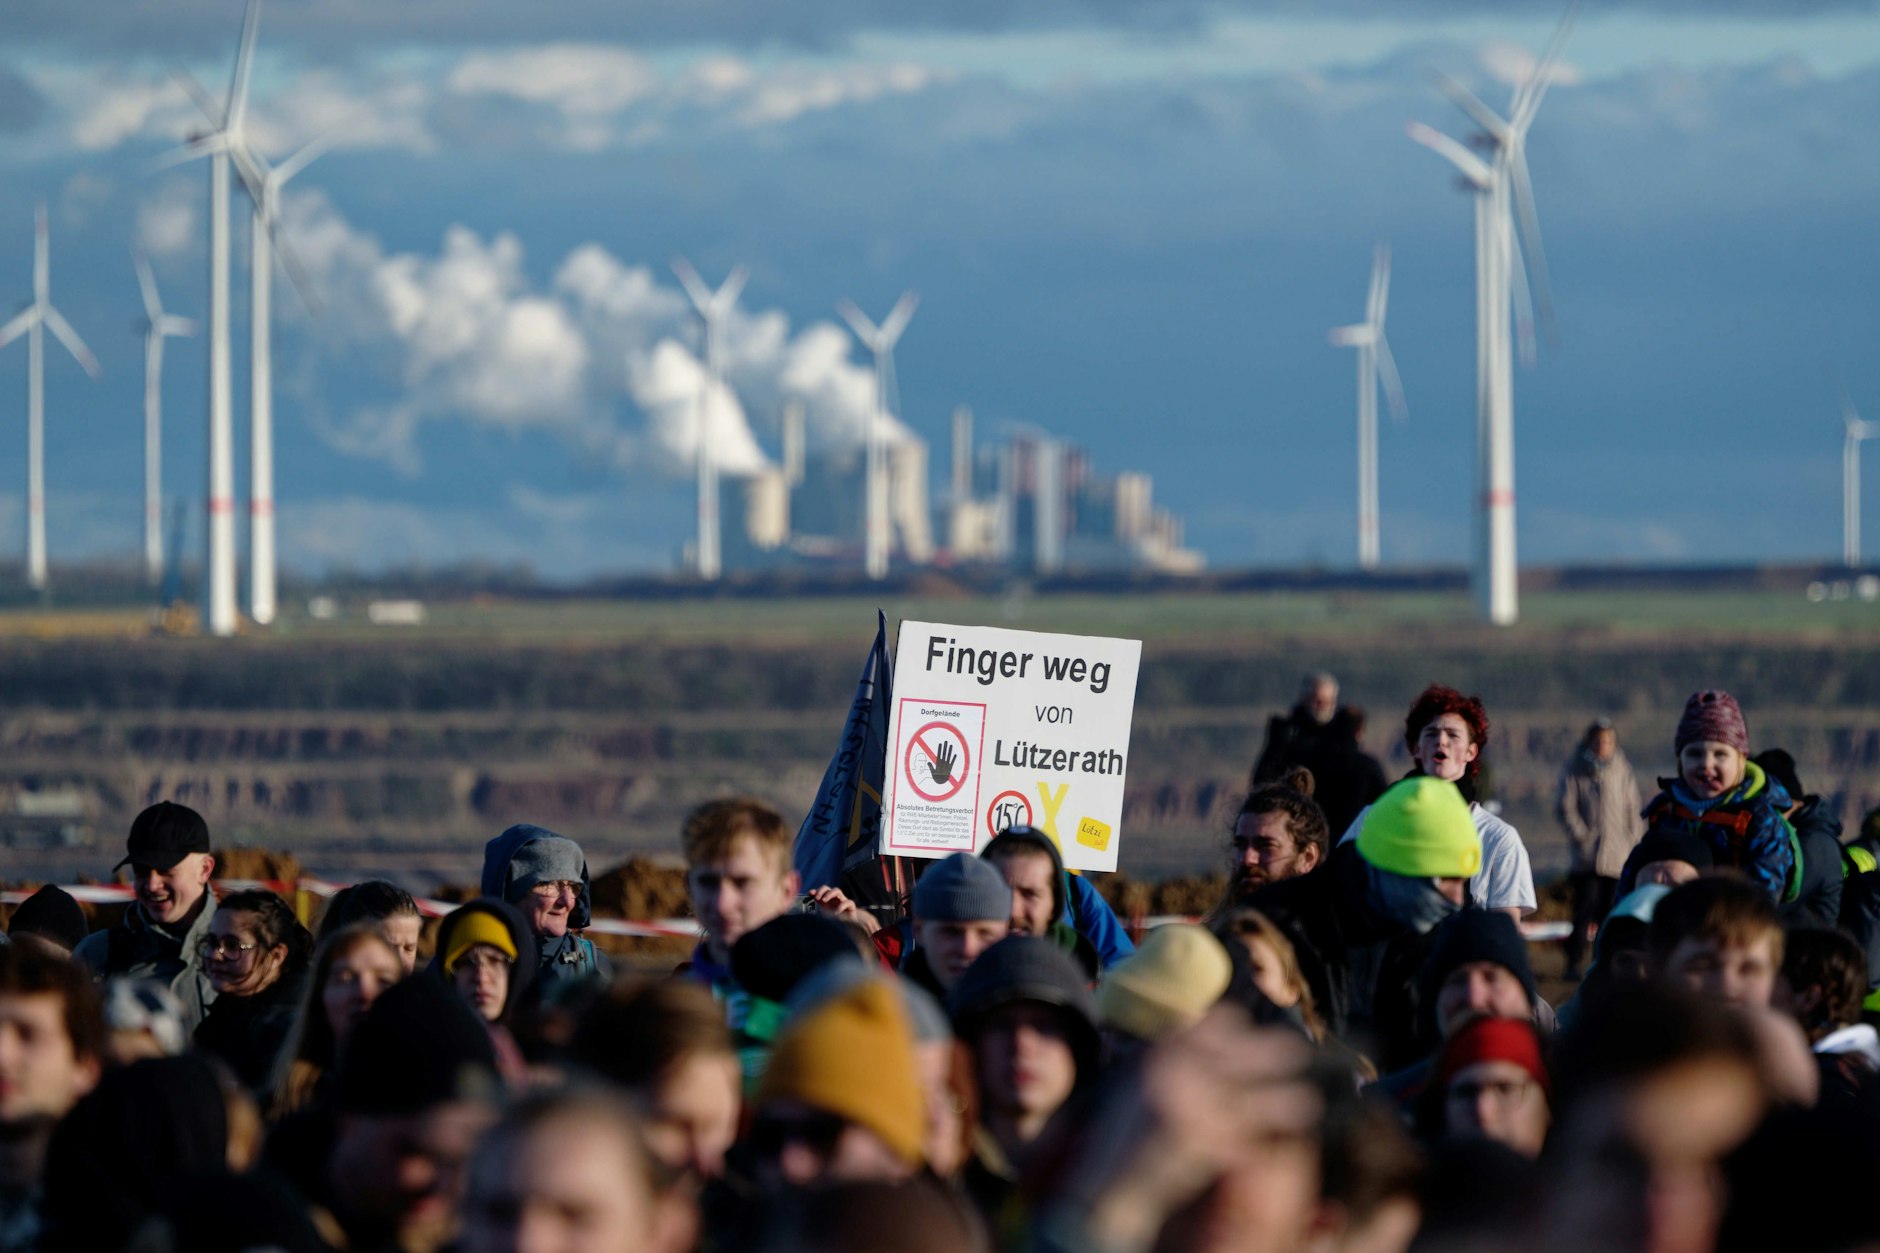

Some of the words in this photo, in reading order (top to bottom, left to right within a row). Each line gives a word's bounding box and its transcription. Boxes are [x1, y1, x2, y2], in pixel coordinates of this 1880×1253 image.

[926, 636, 1034, 685] Finger
[1043, 655, 1111, 694] weg
[920, 708, 961, 718] Dorfgelände
[1035, 705, 1073, 724] von
[994, 739, 1123, 776] Lützerath
[896, 804, 924, 812] Absolutes
[925, 806, 974, 815] Betretungsverbot
